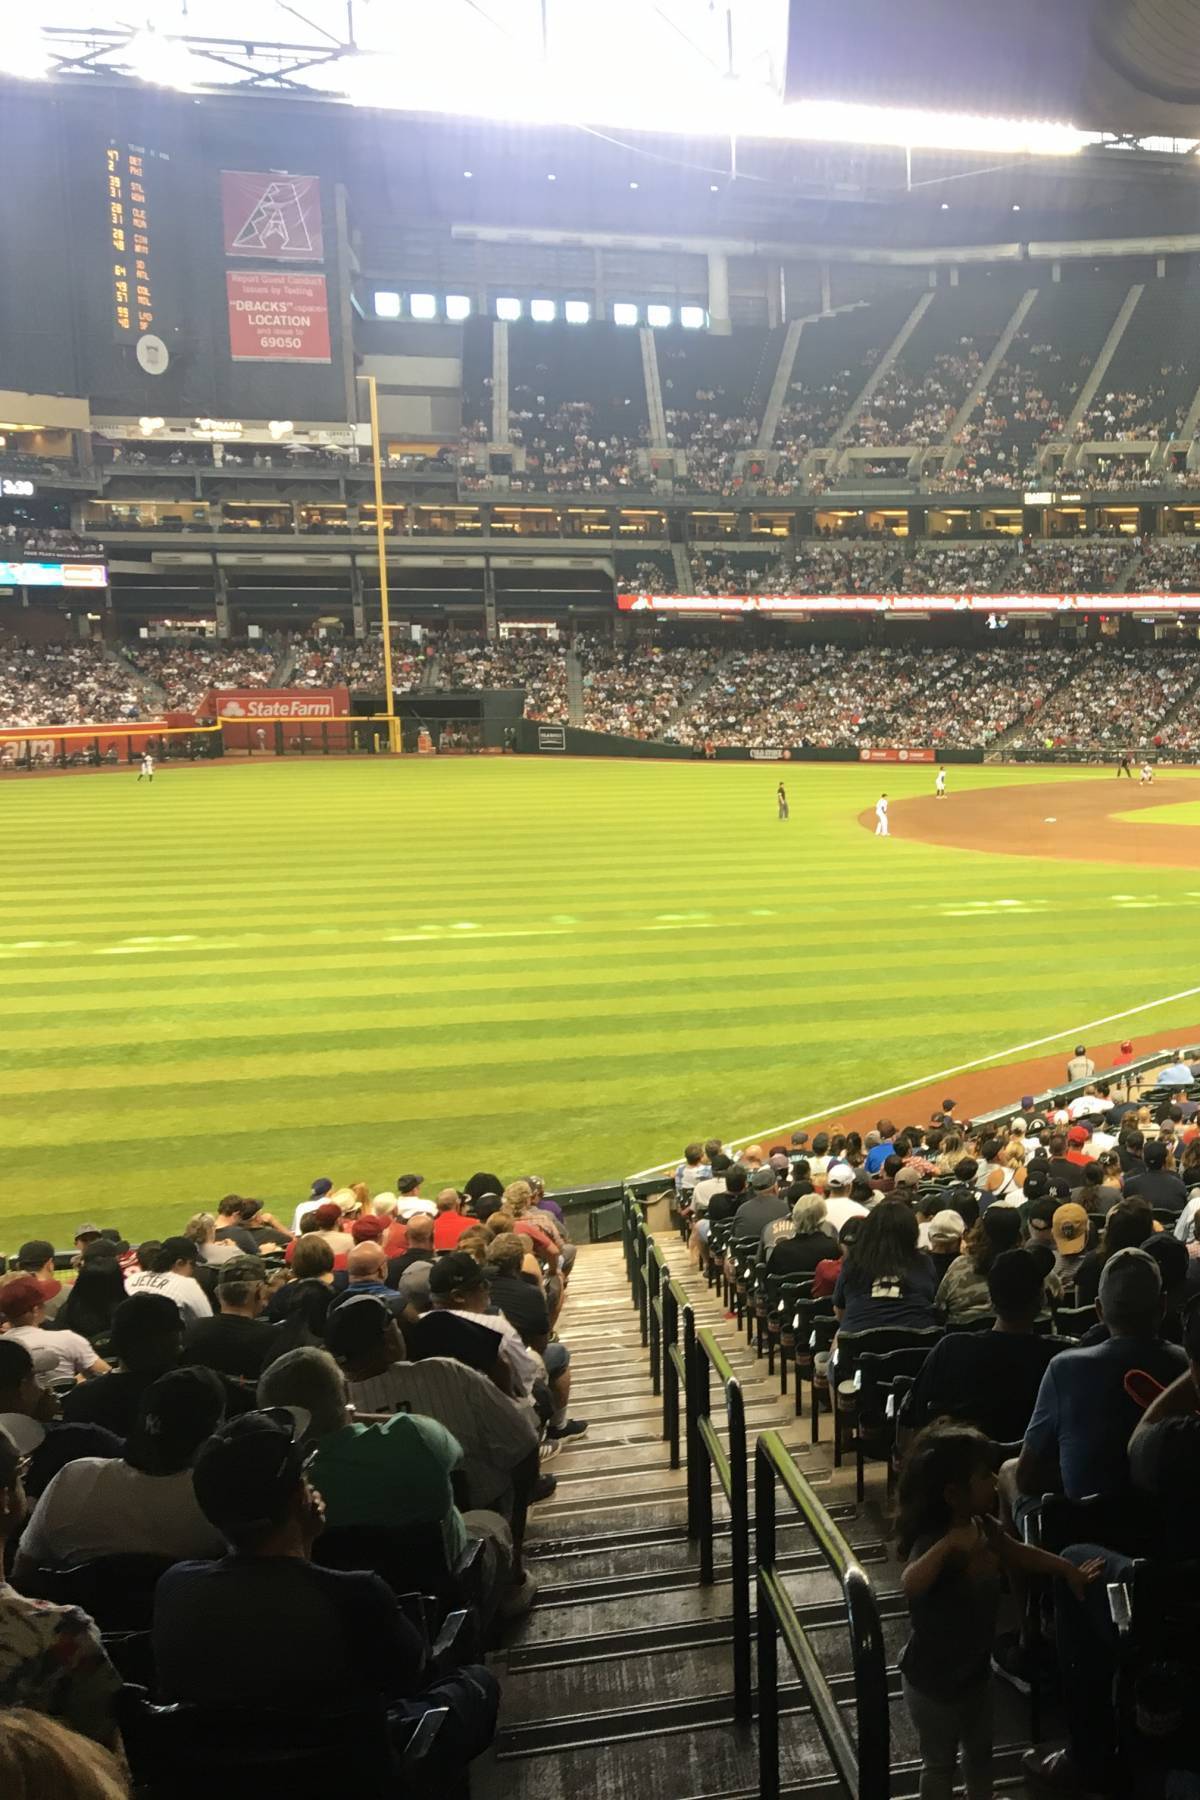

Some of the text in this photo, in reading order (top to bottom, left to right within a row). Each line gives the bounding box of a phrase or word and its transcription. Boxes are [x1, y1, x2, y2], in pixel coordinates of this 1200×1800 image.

[248, 314, 311, 327] LOCATION
[260, 336, 302, 349] 69050
[131, 1274, 169, 1290] JETER
